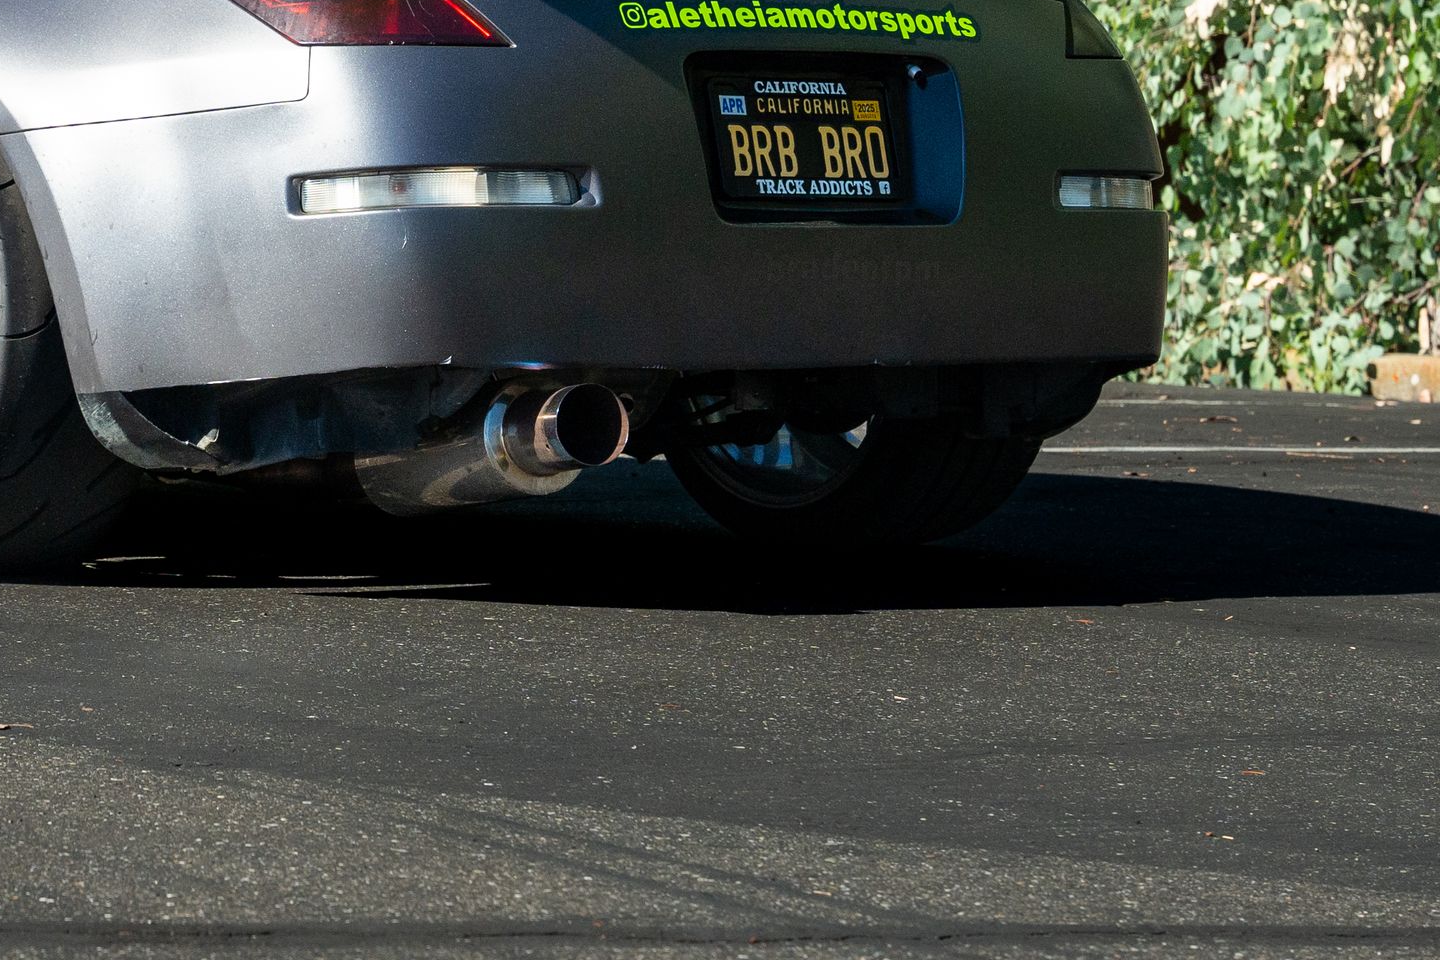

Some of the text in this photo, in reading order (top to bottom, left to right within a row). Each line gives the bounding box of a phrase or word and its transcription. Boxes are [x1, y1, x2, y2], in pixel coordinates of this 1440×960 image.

[754, 80, 847, 95] CALIFORNIA
[722, 98, 745, 113] APR
[756, 97, 849, 115] CALIFORNIA
[857, 103, 875, 113] 2025
[728, 124, 890, 179] BRB BRO
[755, 178, 873, 196] TRACK ADDICTS
